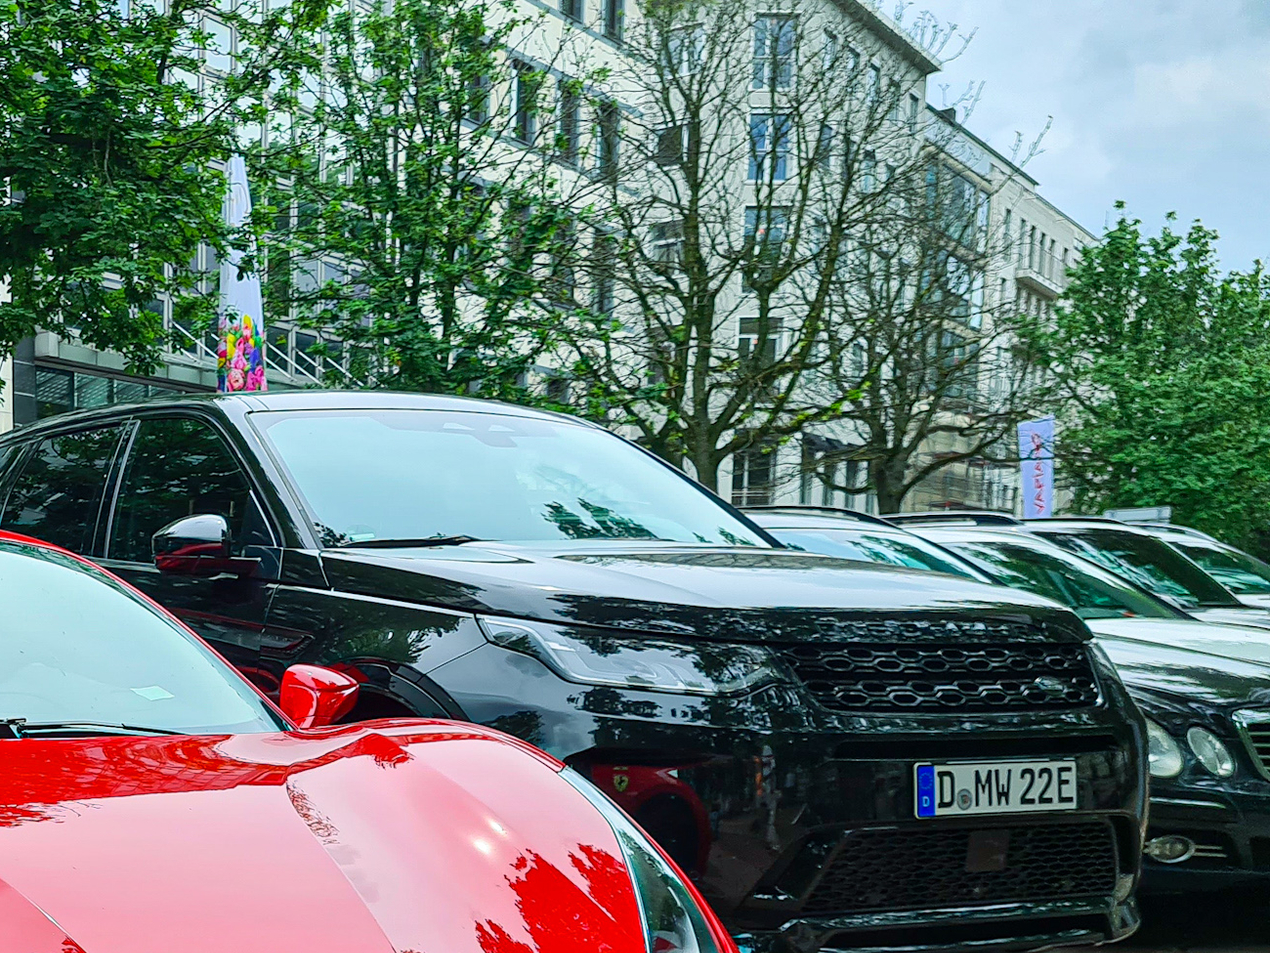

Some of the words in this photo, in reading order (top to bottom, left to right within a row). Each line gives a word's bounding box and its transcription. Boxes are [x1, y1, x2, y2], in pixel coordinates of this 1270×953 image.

[937, 770, 955, 808] D
[974, 769, 1011, 807] MW
[1020, 767, 1074, 805] 22E
[922, 796, 930, 807] D
